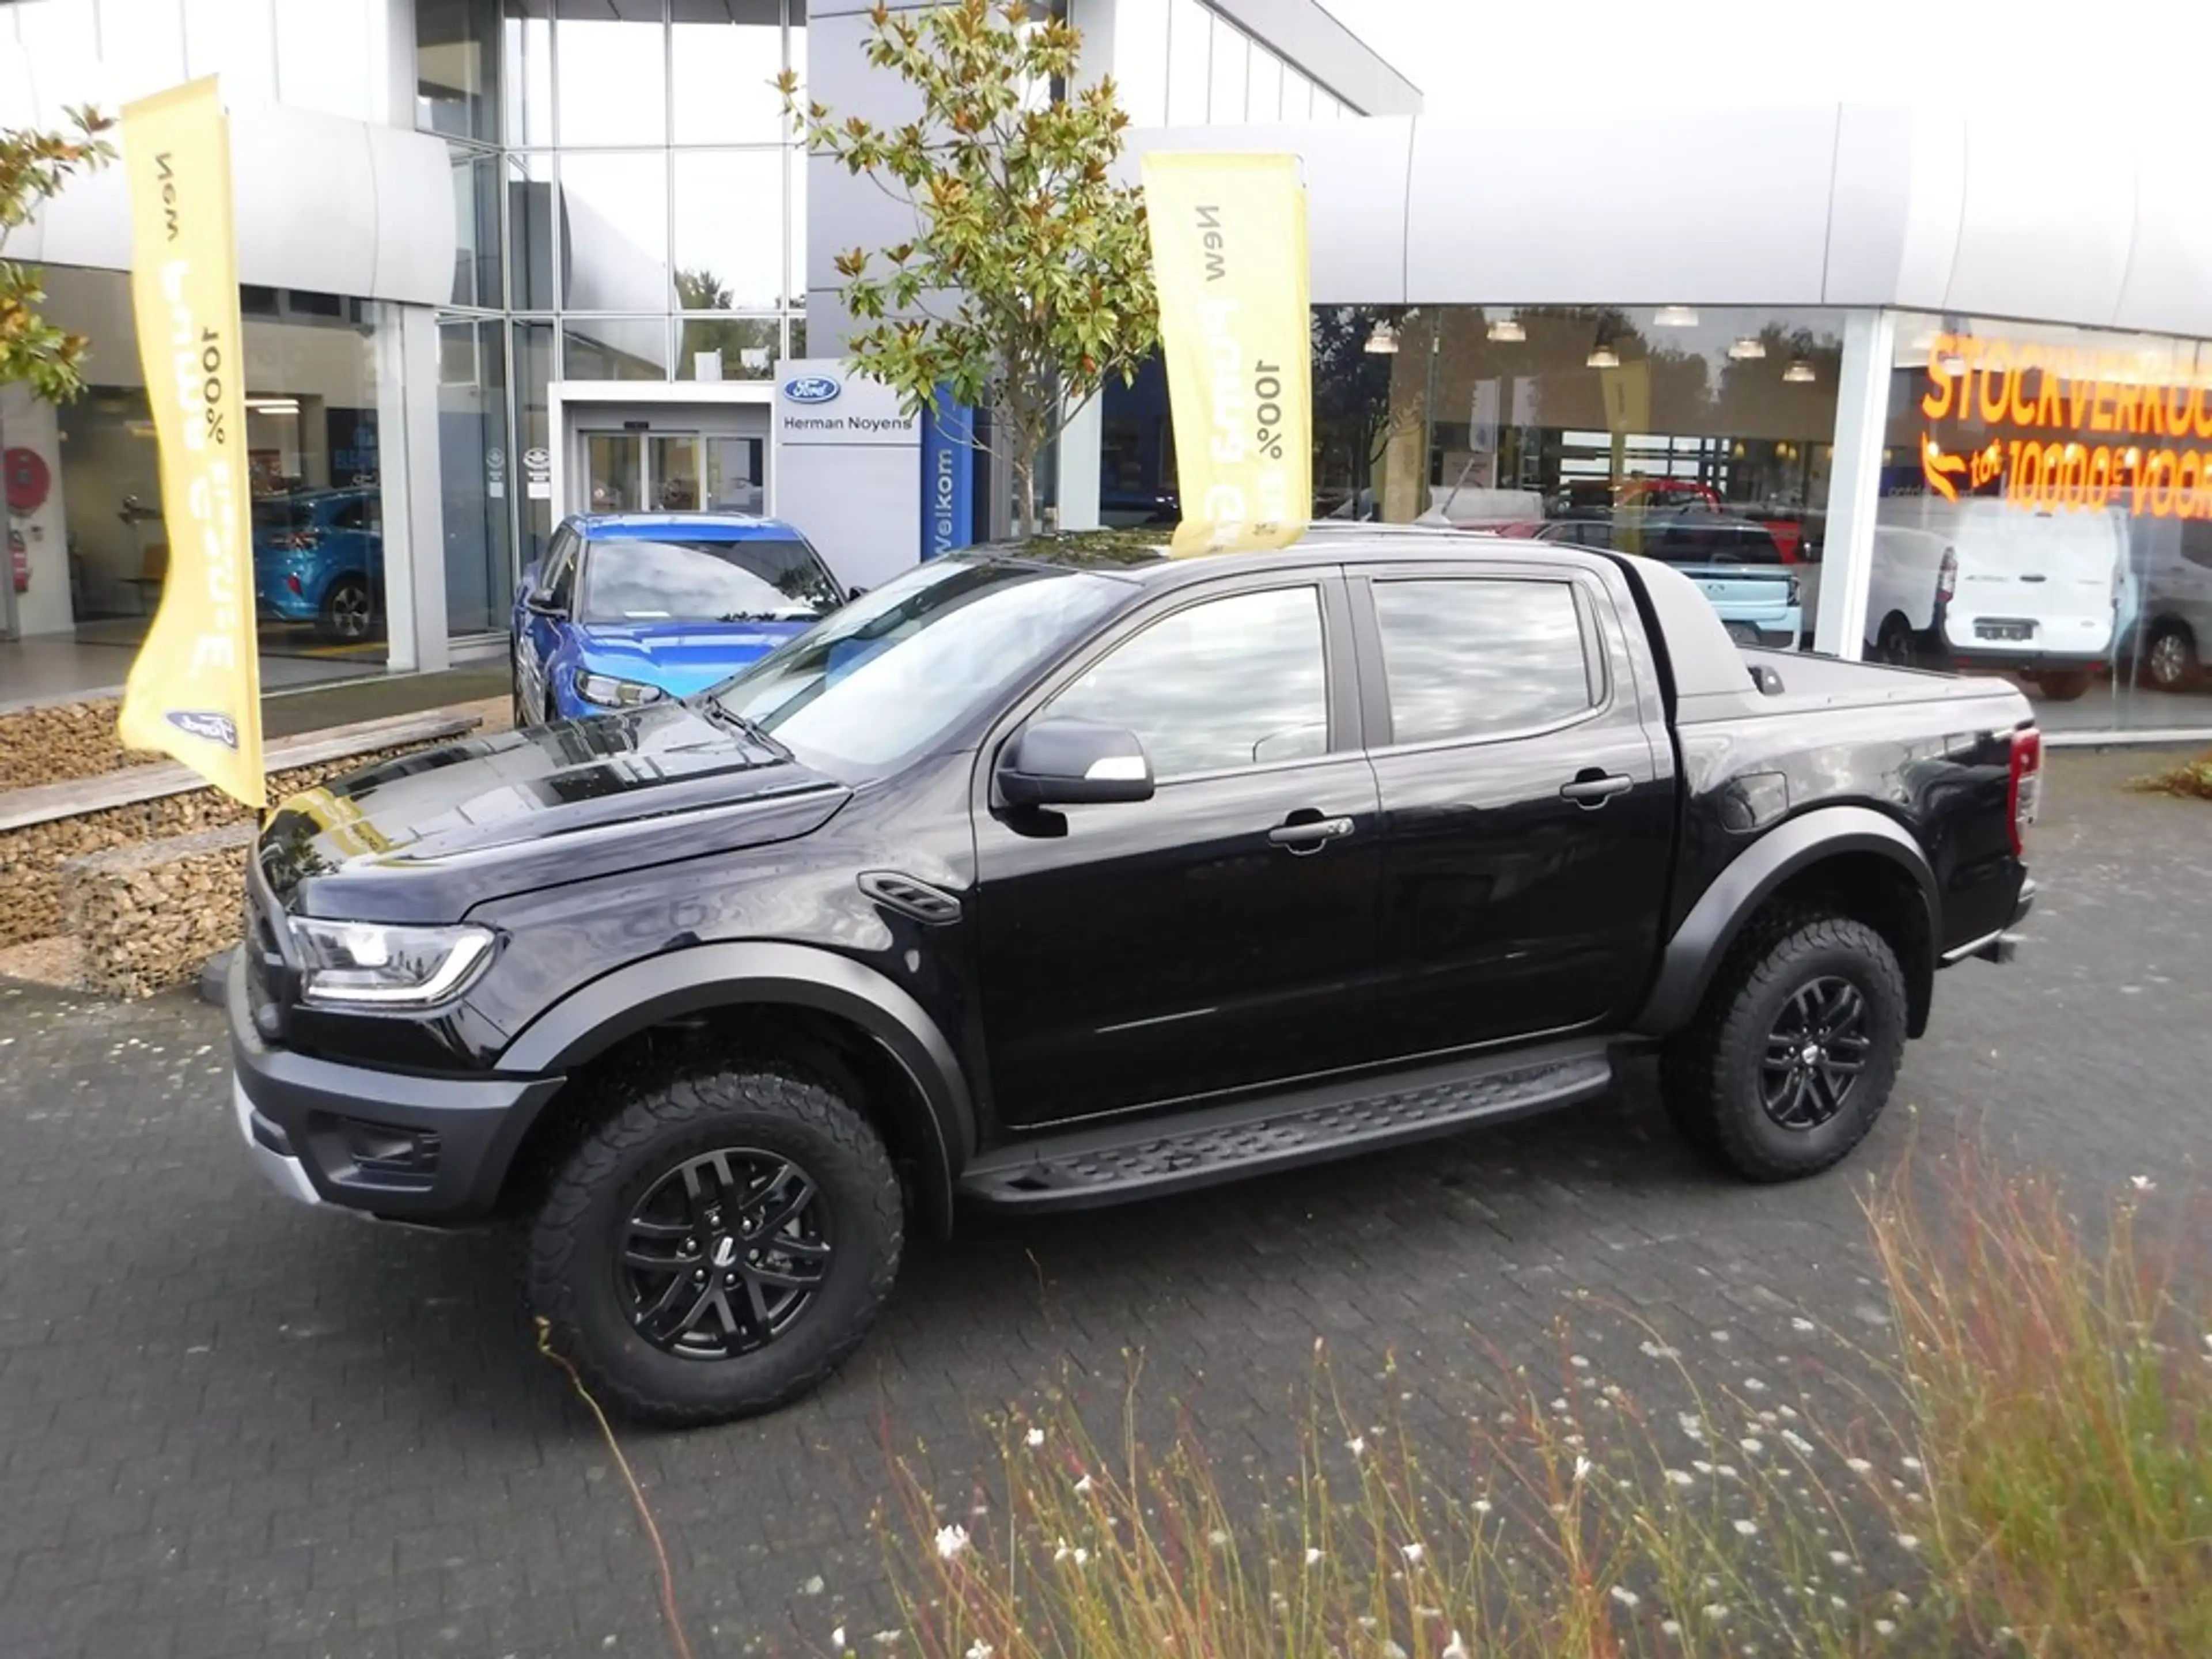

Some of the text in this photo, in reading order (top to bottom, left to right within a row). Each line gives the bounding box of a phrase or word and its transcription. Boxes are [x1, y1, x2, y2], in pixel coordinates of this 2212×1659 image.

[784, 416, 912, 432] Herman Noyens
[1971, 438, 2002, 488] tot
